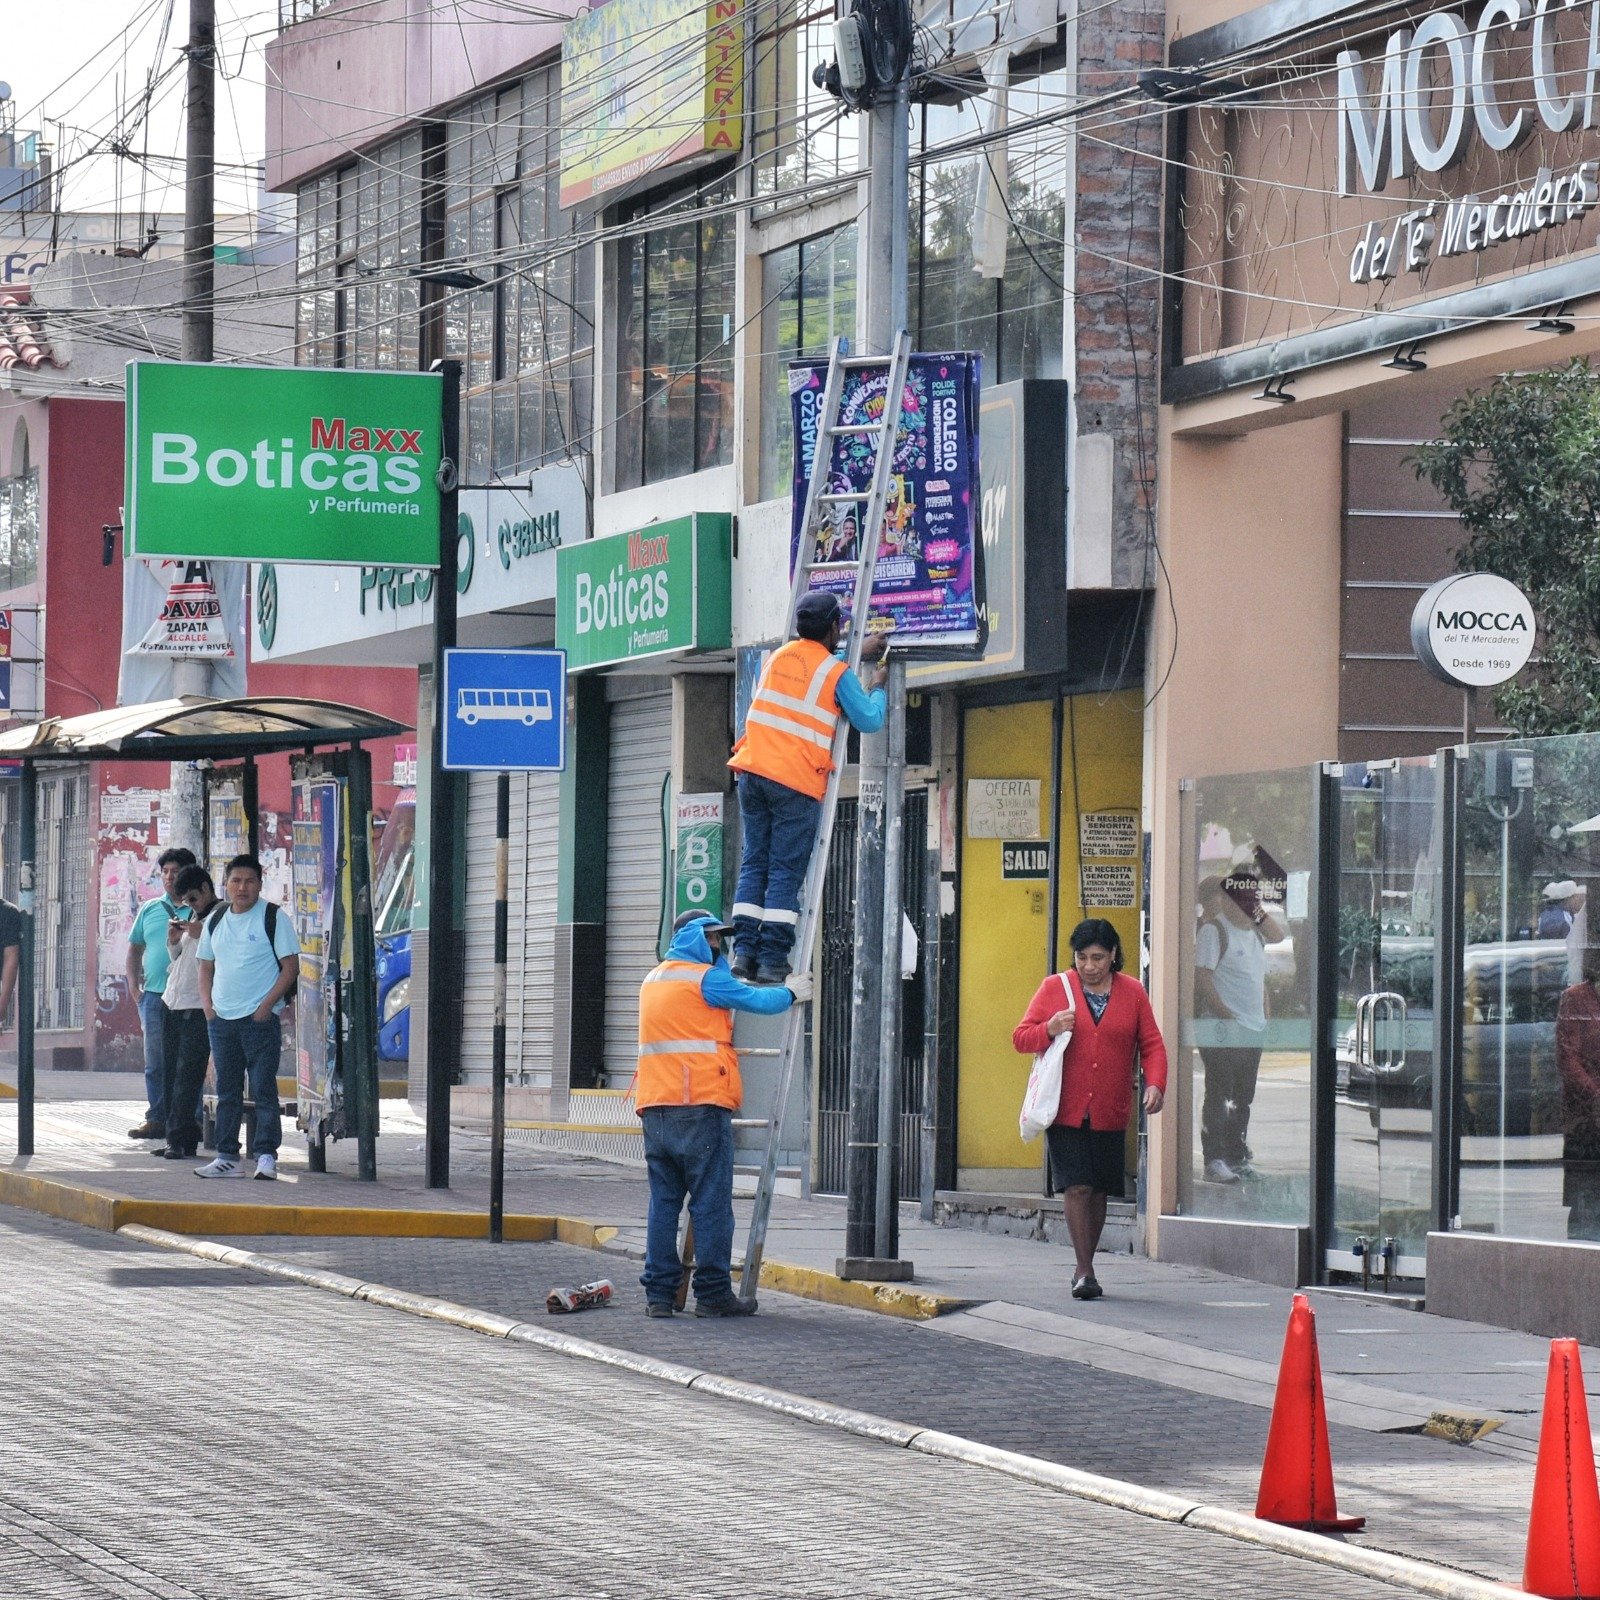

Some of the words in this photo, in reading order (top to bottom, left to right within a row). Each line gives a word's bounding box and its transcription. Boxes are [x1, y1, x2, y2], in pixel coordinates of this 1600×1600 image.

[711, 0, 737, 148] NATERIA
[1350, 221, 1402, 283] del
[1401, 199, 1437, 267] Té
[1437, 162, 1590, 257] Mercaderes
[842, 375, 890, 424] CONVENCIO
[310, 416, 424, 455] Maxx
[800, 389, 816, 461] MARZO
[931, 399, 942, 473] INDEPENDENCIA
[942, 397, 958, 472] COLEGIO
[151, 431, 422, 494] Boticas
[308, 499, 320, 514] y
[324, 496, 420, 516] Perfumería
[512, 510, 562, 559] 381111
[628, 531, 669, 573] Maxx
[360, 512, 474, 616] PRESO
[840, 568, 861, 580] KEYE
[576, 563, 669, 635] Boticas
[166, 622, 209, 633] ZAPATA
[1436, 611, 1528, 631] MOCCA
[139, 642, 194, 652] USTAMANTE
[167, 633, 208, 642] ALCALDE
[633, 624, 669, 650] Perfumería
[1444, 634, 1457, 643] del
[1460, 634, 1470, 643] Té
[1471, 635, 1520, 644] Mercaderes
[1452, 658, 1484, 669] Desde
[1488, 660, 1511, 669] 1969
[985, 781, 1031, 797] OFERTA
[996, 798, 1004, 810] 3
[1097, 815, 1135, 823] NECESITA
[1004, 850, 1050, 871] SALID
[1225, 878, 1287, 890] Protección
